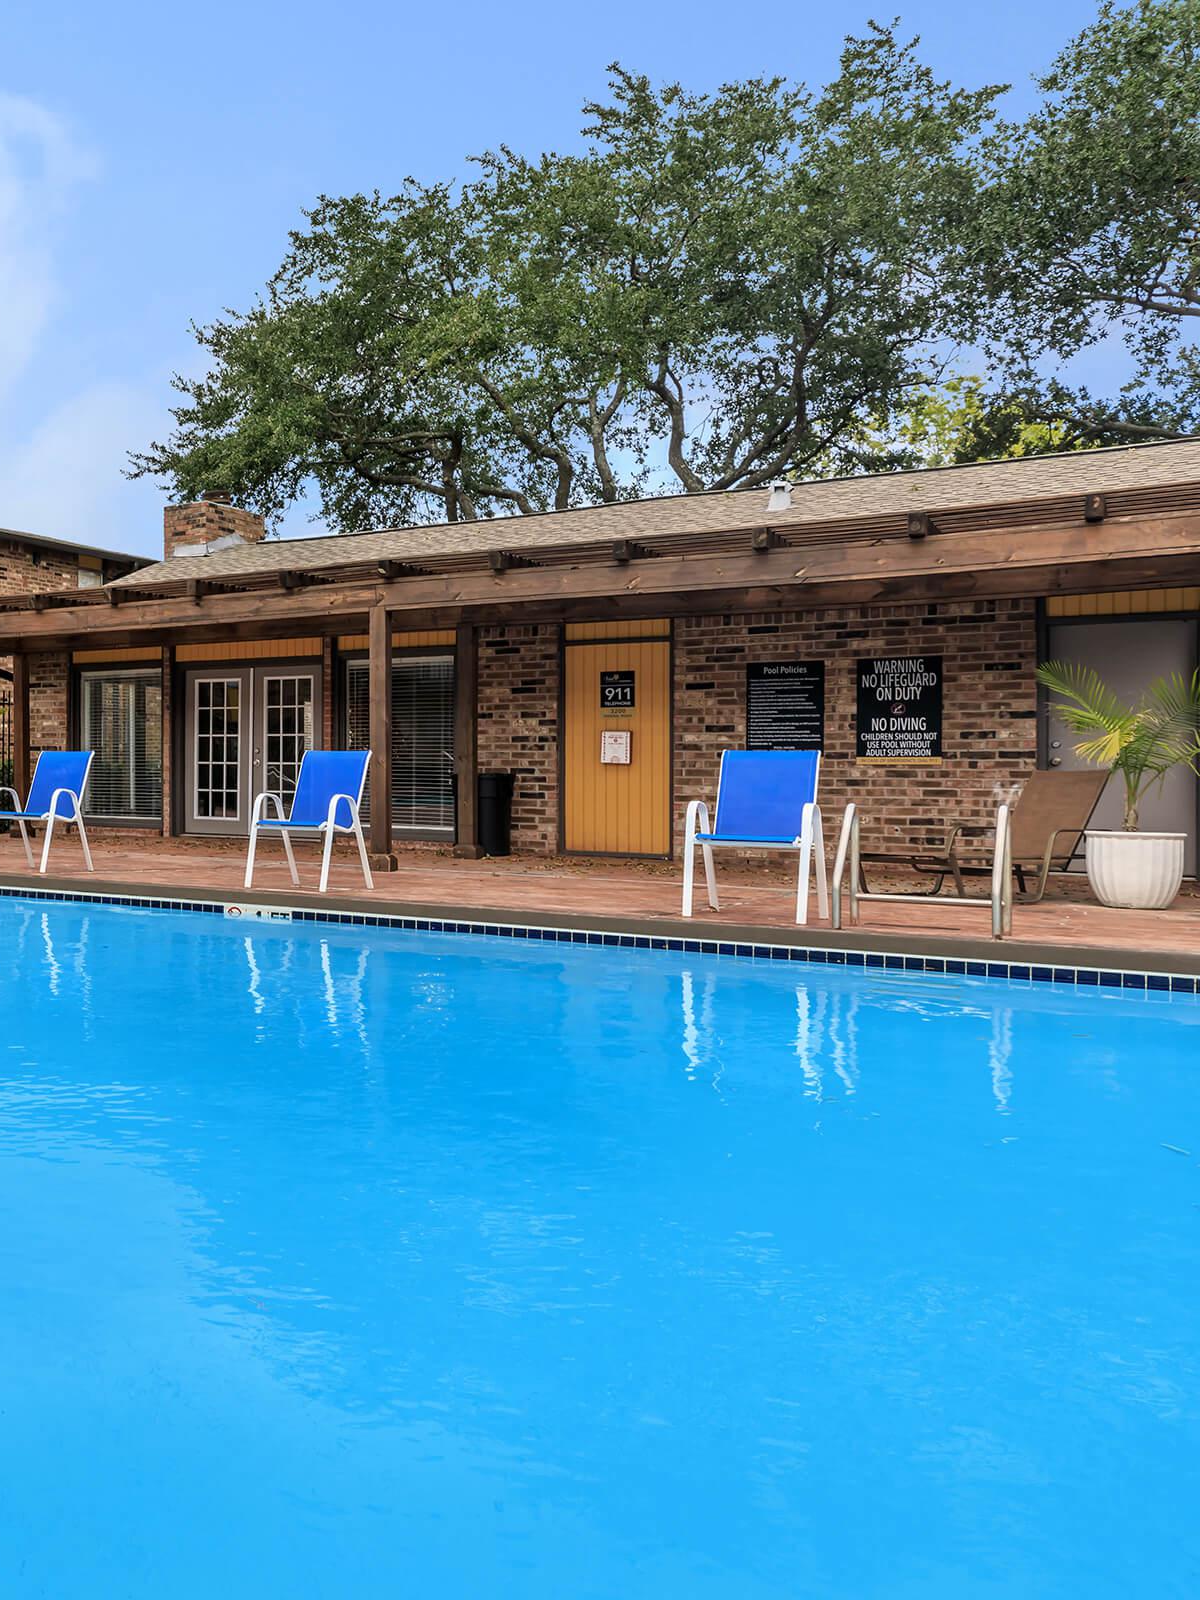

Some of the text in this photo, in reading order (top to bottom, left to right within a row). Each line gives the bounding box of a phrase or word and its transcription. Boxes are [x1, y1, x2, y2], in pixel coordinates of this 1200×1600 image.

[763, 665, 807, 674] Pool Policies
[873, 659, 925, 674] WARNING
[861, 672, 937, 688] NO LIFEGUARD
[605, 687, 631, 700] 911
[876, 686, 922, 701] ON DUTY
[871, 717, 927, 731] NO DIVING
[860, 732, 938, 741] CHILDREN SHOULD NOT
[866, 740, 931, 749] USE POOL WITHOUT
[866, 748, 932, 757] ADULT SUPERVISION
